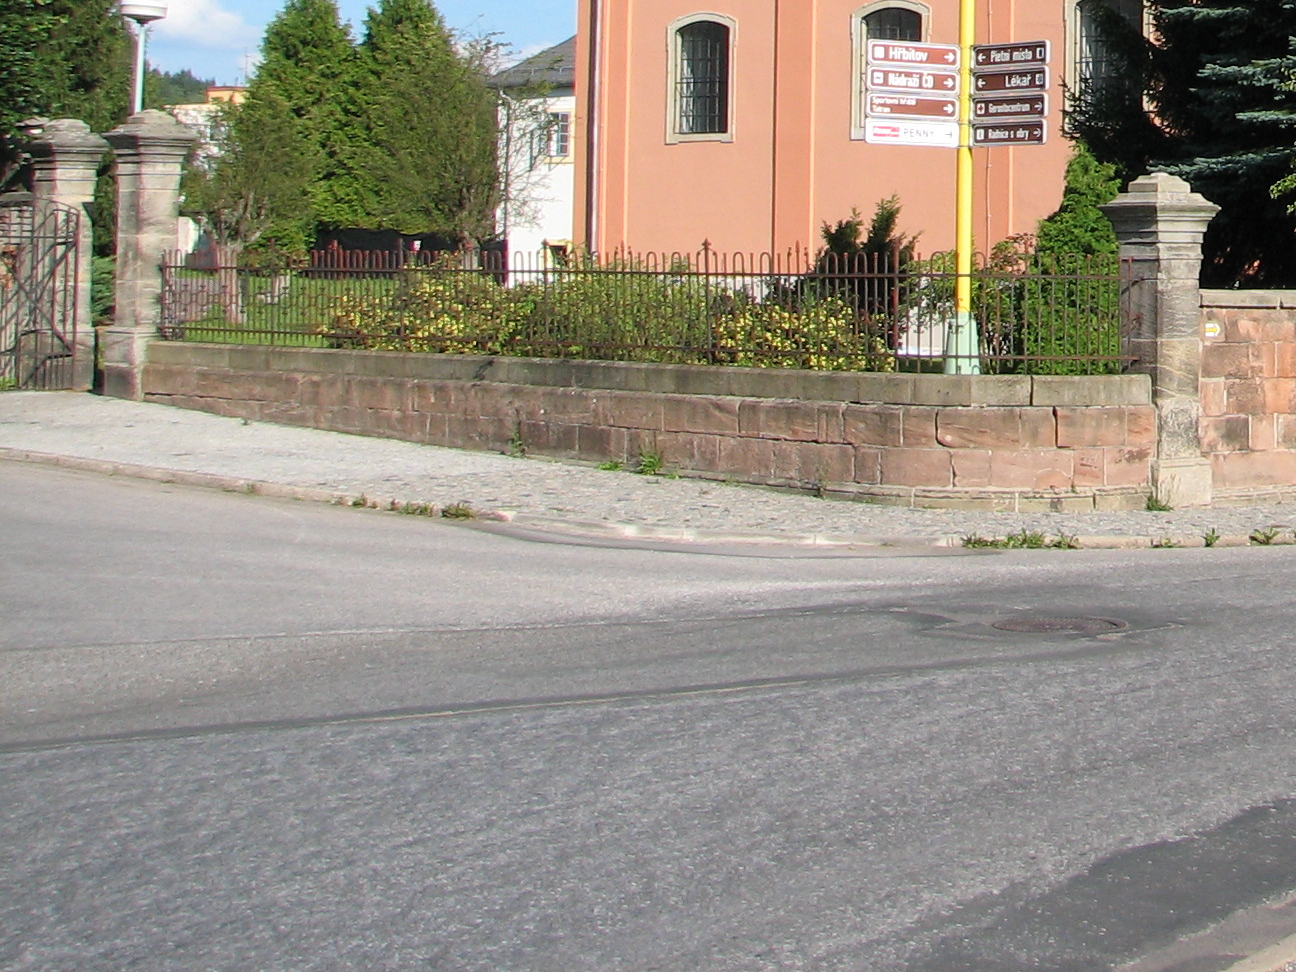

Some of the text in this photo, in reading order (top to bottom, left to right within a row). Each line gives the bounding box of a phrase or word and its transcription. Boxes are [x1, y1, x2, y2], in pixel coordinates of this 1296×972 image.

[889, 46, 928, 62] Hřbitov
[888, 72, 920, 88] Nádraží
[1005, 73, 1032, 88] Lékař
[903, 128, 934, 138] PENNY
